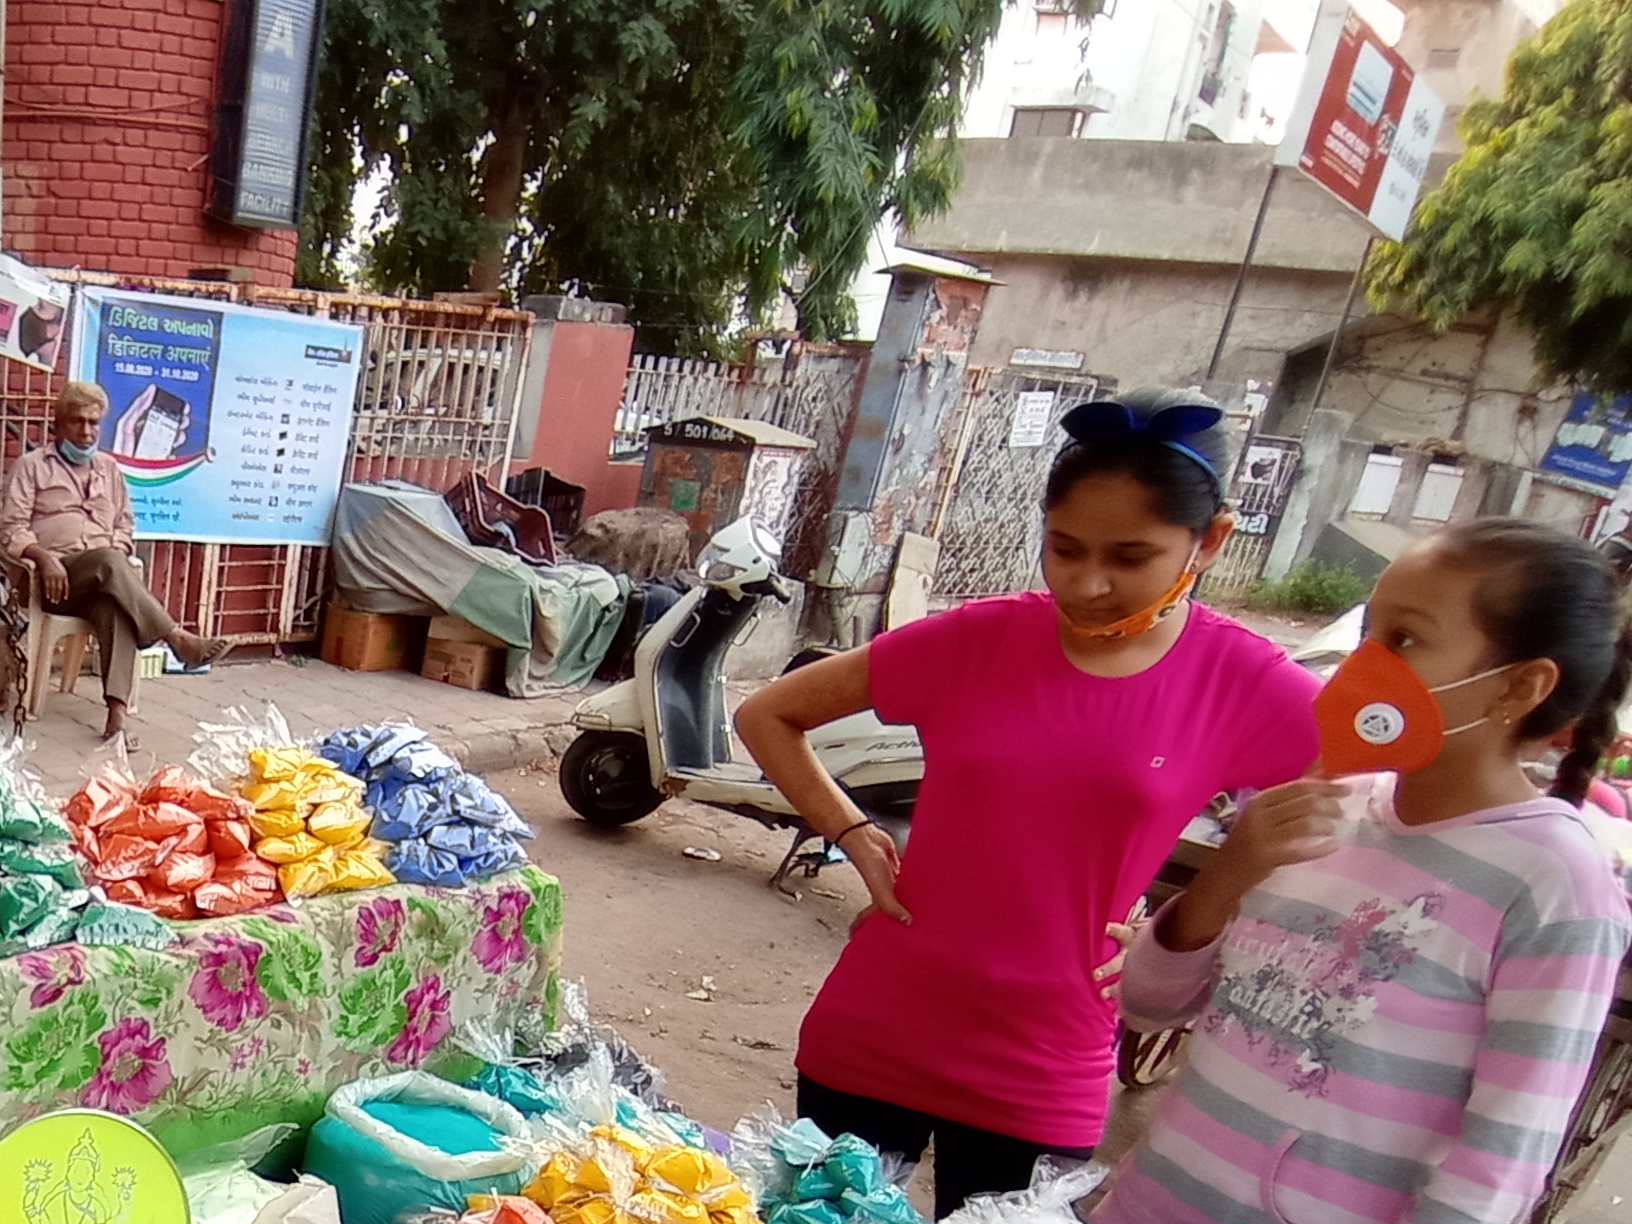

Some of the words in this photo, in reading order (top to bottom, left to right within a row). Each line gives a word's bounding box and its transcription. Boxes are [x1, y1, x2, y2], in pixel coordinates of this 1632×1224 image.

[108, 306, 158, 331] ડિજિટલ
[163, 318, 214, 339] અપનાવો
[107, 333, 164, 360] डिजिटल
[166, 346, 211, 371] अपनाएं
